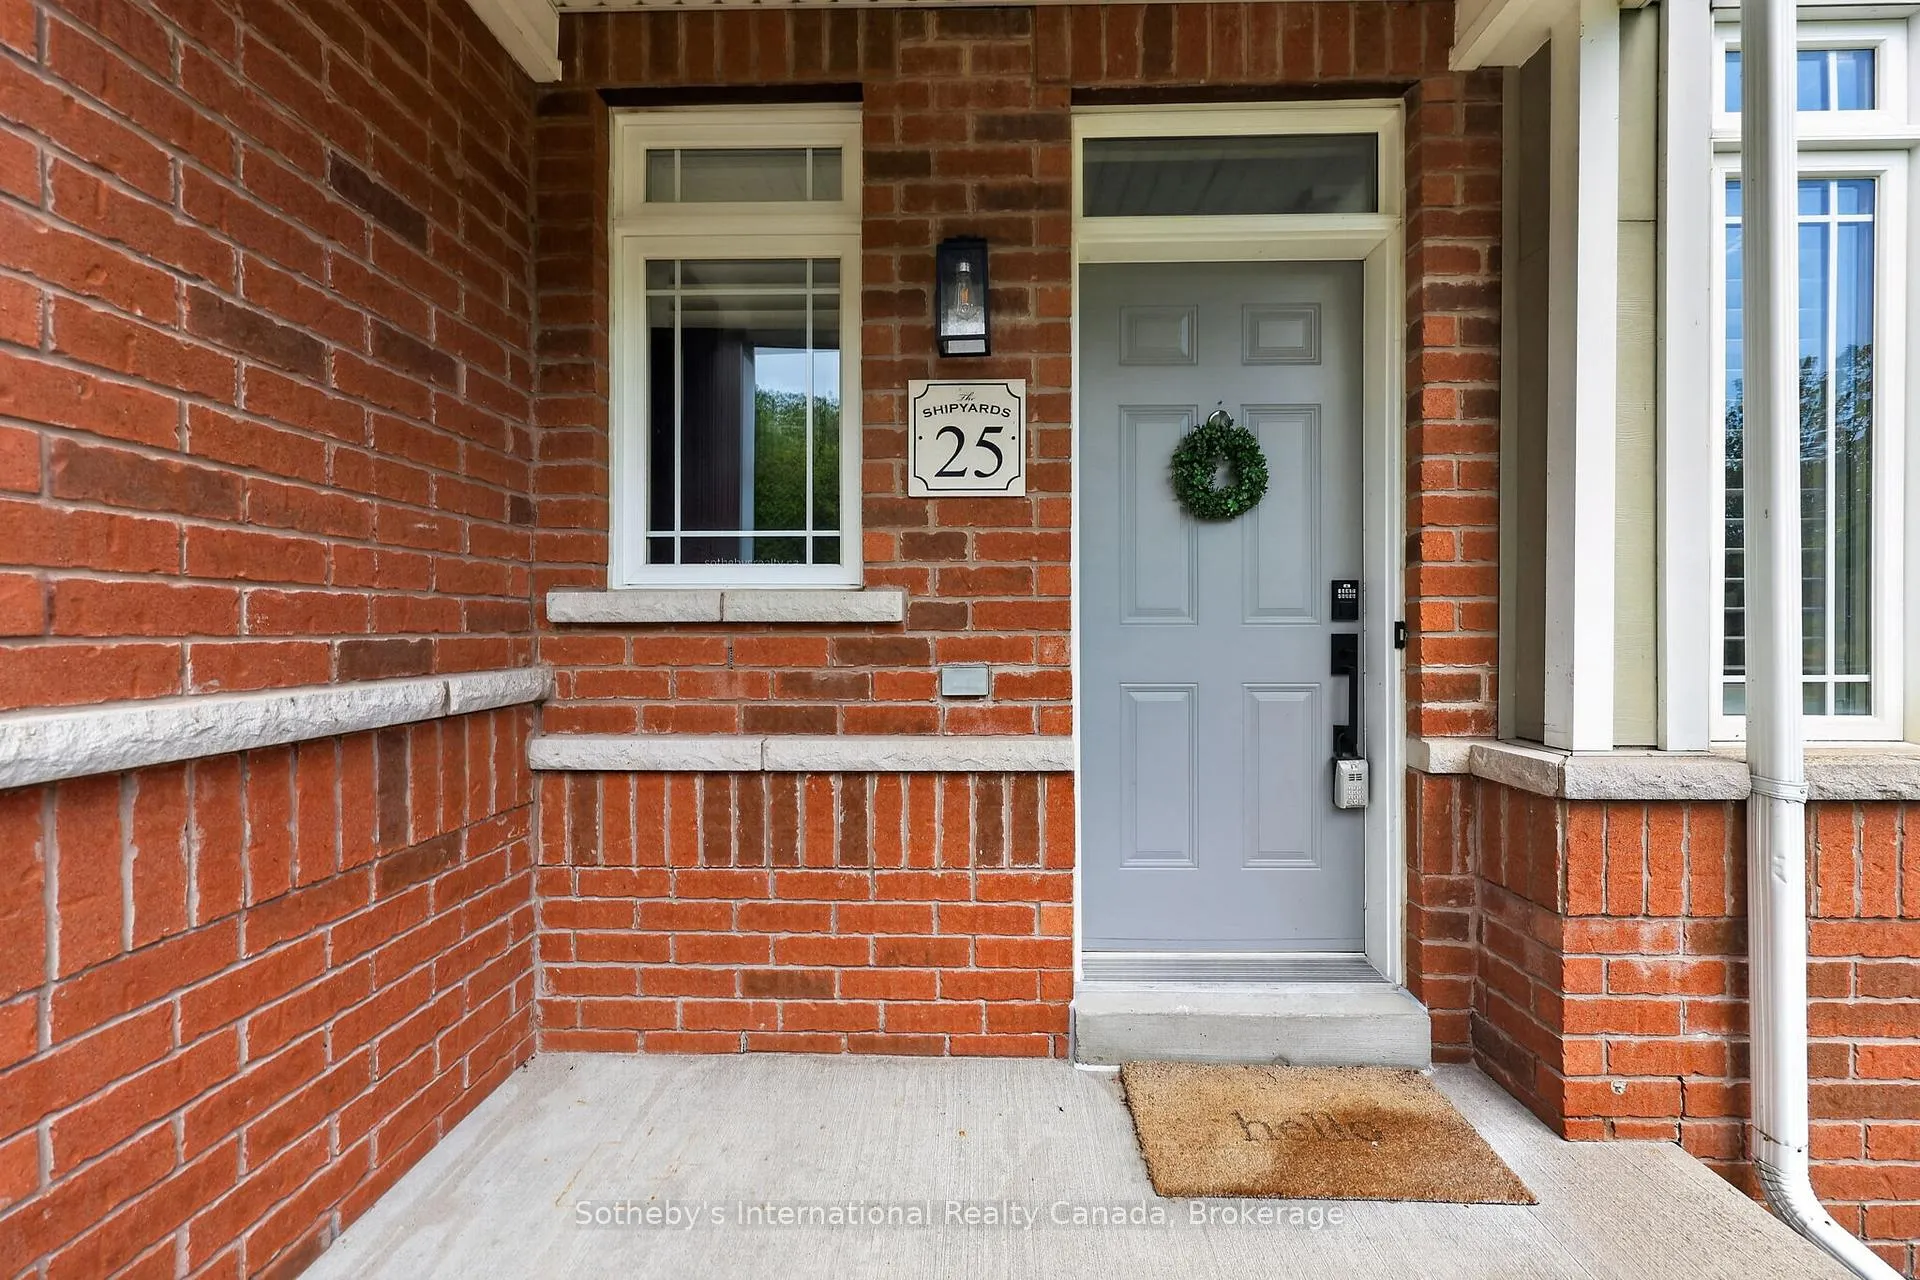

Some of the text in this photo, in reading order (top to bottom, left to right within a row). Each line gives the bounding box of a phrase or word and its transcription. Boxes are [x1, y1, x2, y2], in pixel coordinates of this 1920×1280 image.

[957, 391, 976, 402] The
[922, 402, 1012, 419] SHIPYARDS
[934, 425, 1004, 478] 25
[1229, 1110, 1384, 1143] hello
